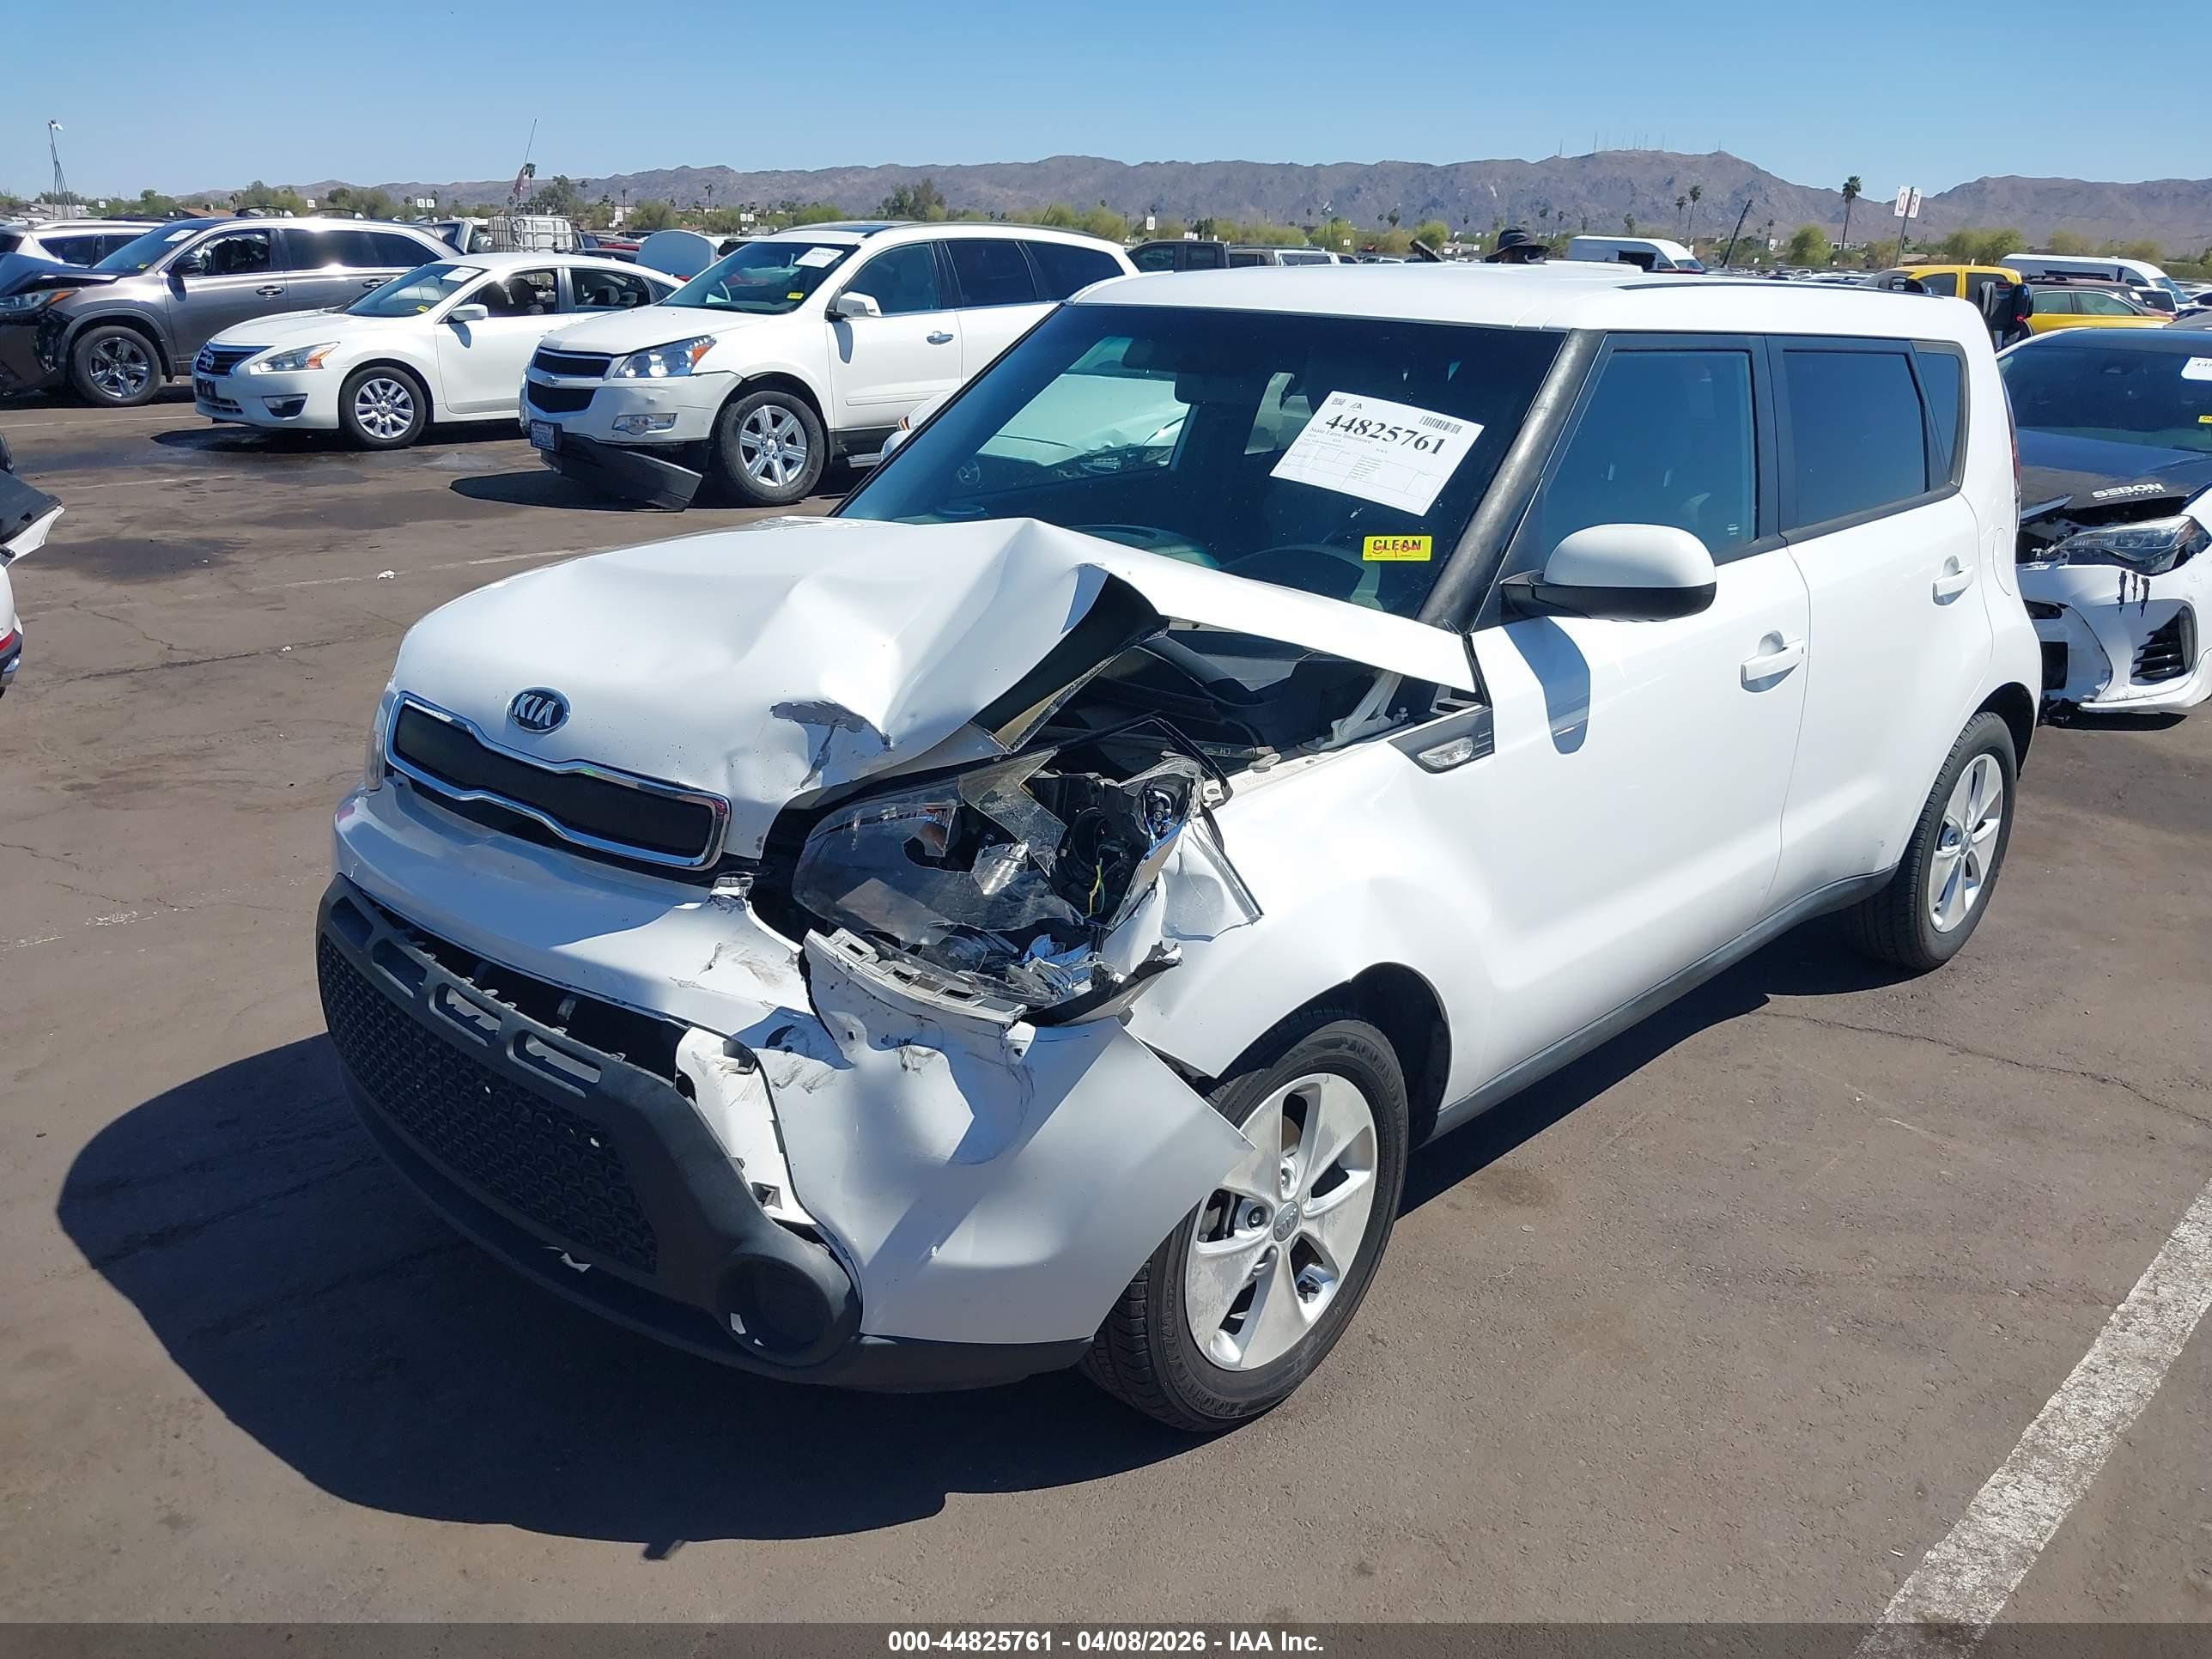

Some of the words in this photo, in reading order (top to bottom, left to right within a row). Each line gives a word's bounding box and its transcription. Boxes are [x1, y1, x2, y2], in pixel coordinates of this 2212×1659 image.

[1899, 192, 1905, 211] Q
[1911, 194, 1918, 213] R
[1326, 415, 1445, 454] 44825761
[1343, 433, 1373, 445] Insurance
[2092, 483, 2164, 498] SEBON
[1373, 540, 1421, 550] CLEAN
[514, 693, 556, 726] KIA
